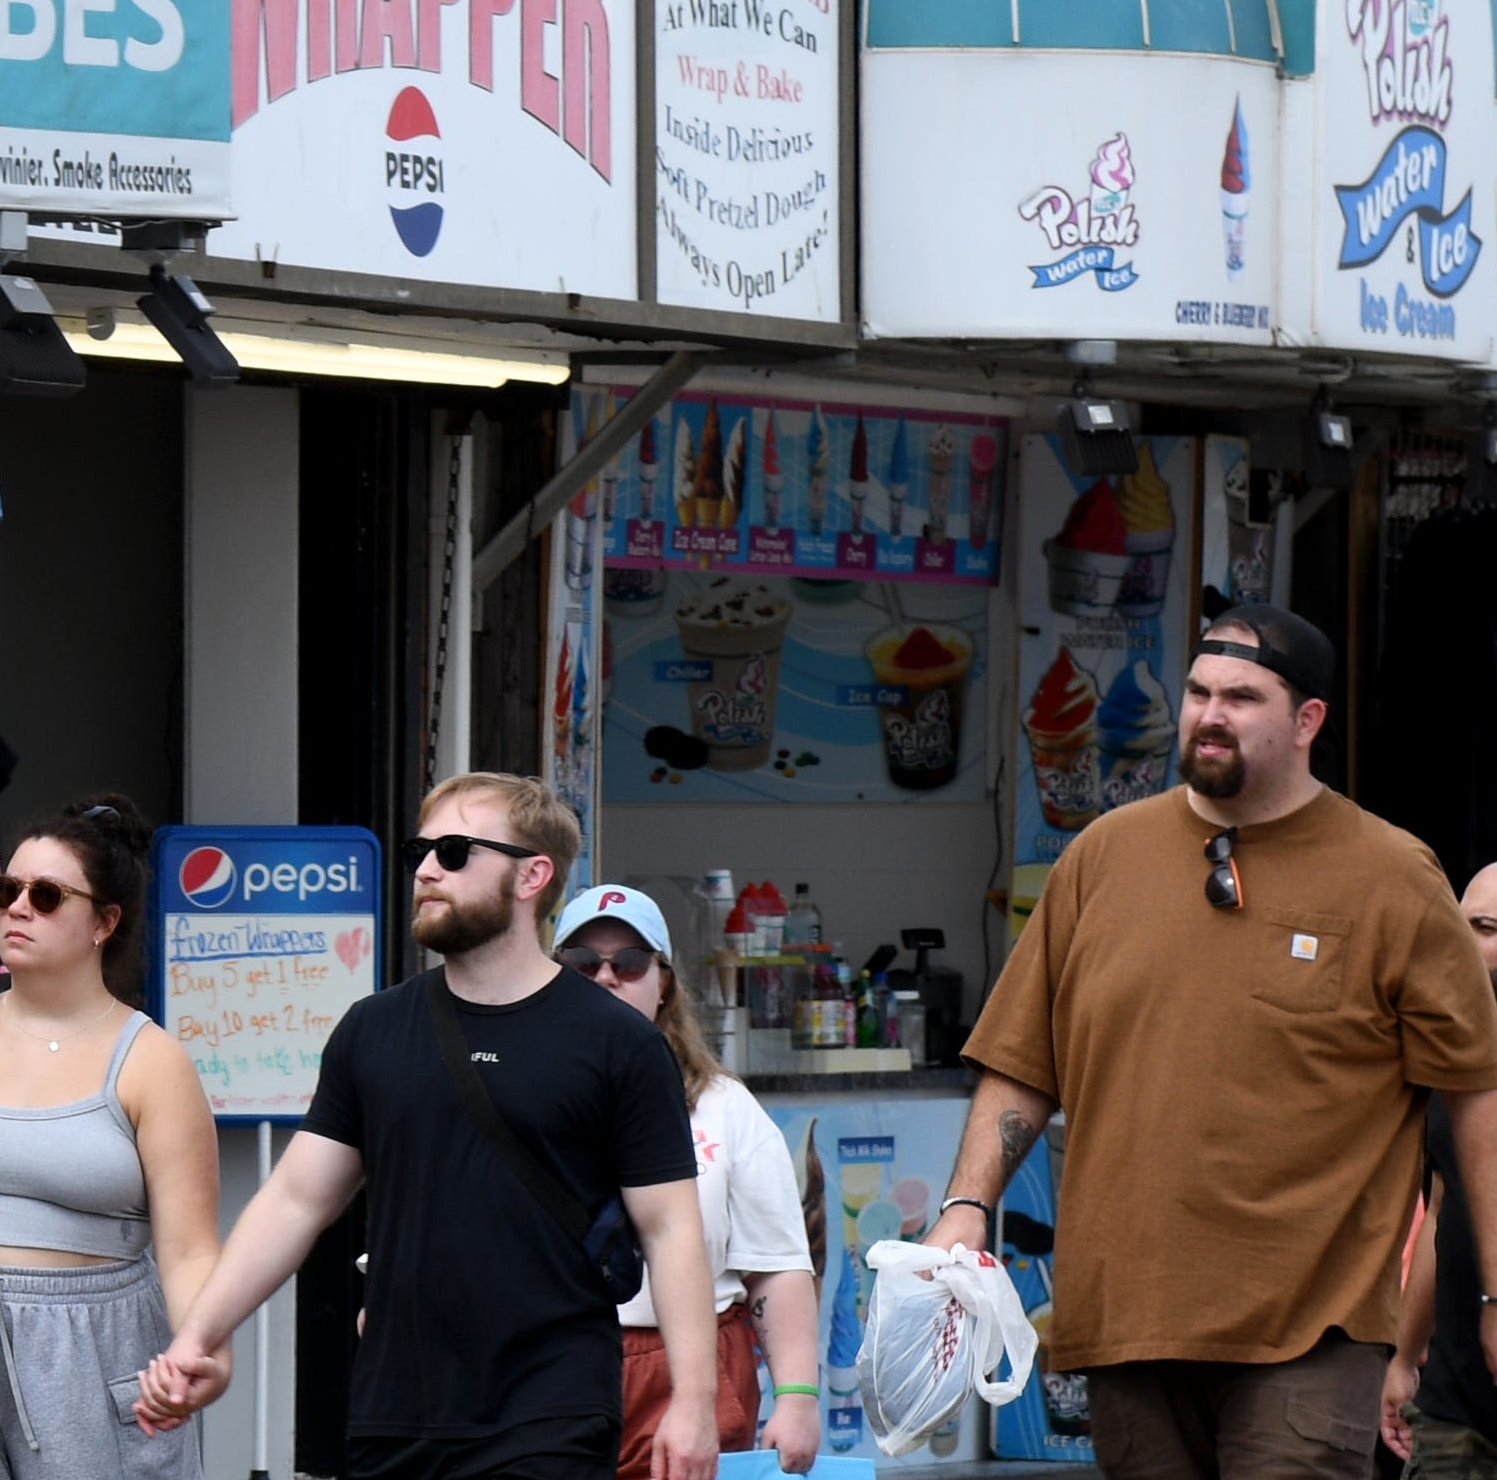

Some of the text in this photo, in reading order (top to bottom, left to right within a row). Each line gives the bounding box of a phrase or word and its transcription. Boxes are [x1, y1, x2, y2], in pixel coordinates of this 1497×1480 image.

[663, 1, 683, 31] At
[779, 9, 817, 53] Can
[678, 55, 803, 104] Wrap & Bake
[665, 105, 813, 161] Inside Delicious
[54, 150, 102, 189] Smoke
[109, 152, 192, 194] Accessories
[385, 153, 444, 193] PEPSI
[695, 179, 758, 229] Pretzel
[765, 171, 826, 225] Dough
[1019, 186, 1139, 250] Polish
[727, 261, 775, 308] Open
[782, 209, 827, 285] Late!
[1430, 222, 1467, 282] Ice
[1104, 271, 1131, 285] Ice
[1360, 277, 1455, 340] Ice Cream
[667, 667, 710, 679] Chiller
[848, 689, 871, 703] Ice
[244, 857, 358, 900] pepsi
[171, 965, 217, 1008] Buy
[223, 962, 238, 988] 5
[246, 967, 271, 997] get
[294, 958, 329, 982] free
[178, 1005, 299, 1046] Buy 10 get 2
